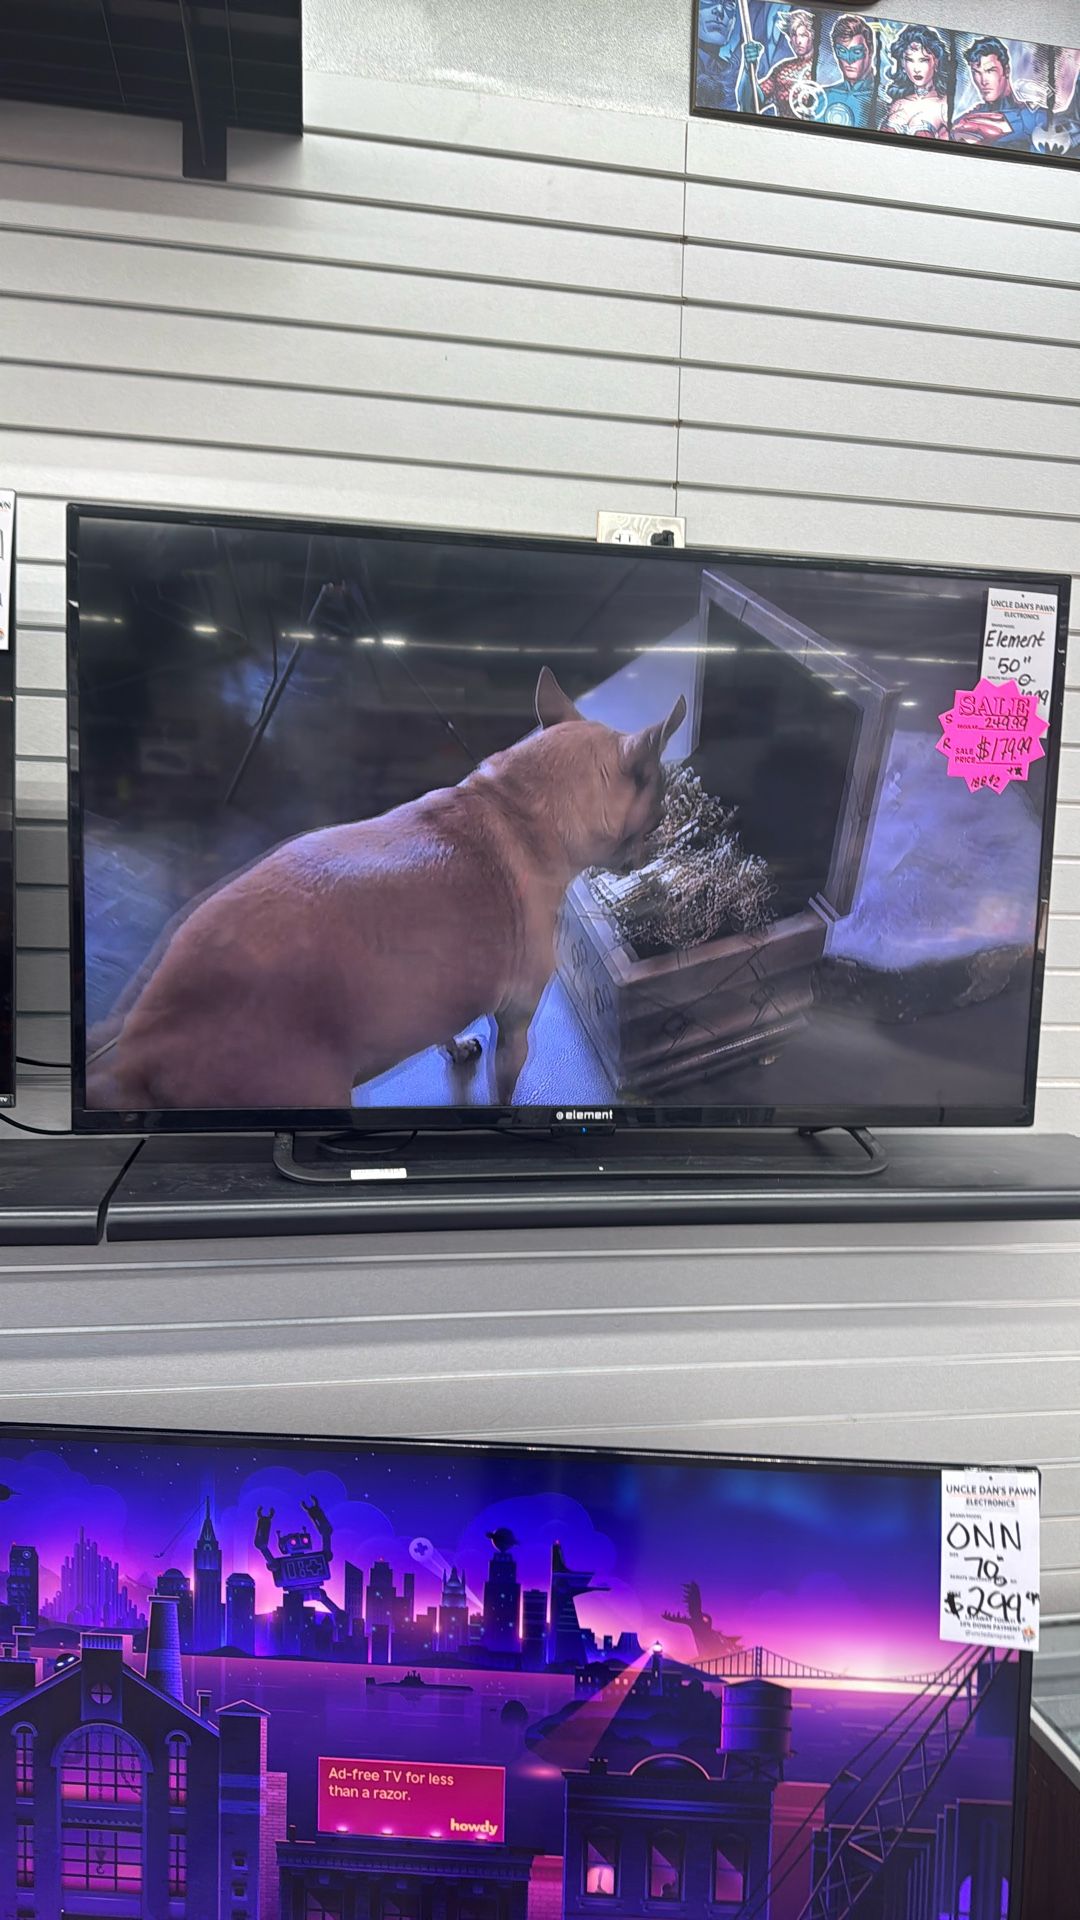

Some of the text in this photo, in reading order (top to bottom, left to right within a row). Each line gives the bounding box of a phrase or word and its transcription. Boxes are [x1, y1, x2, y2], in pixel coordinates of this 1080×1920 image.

[990, 599, 1055, 612] UNCLE DAN'S PAWN
[1004, 612, 1040, 620] ELECTRONICS
[985, 629, 1045, 648] Element
[960, 695, 1030, 717] SALE
[984, 716, 1028, 731] 249.99
[955, 756, 976, 764] PRICE
[565, 1109, 613, 1120] element
[946, 1484, 1036, 1497] UNCLE DAN'S PAWN
[966, 1499, 1015, 1508] ELECTRONICS
[946, 1520, 1021, 1551] ONN
[973, 1621, 992, 1630] DOWN
[993, 1624, 1020, 1632] PAYMENT
[328, 1767, 454, 1786] Ad-free TV for less
[328, 1785, 411, 1801] than a razor.
[450, 1818, 498, 1836] howdy
